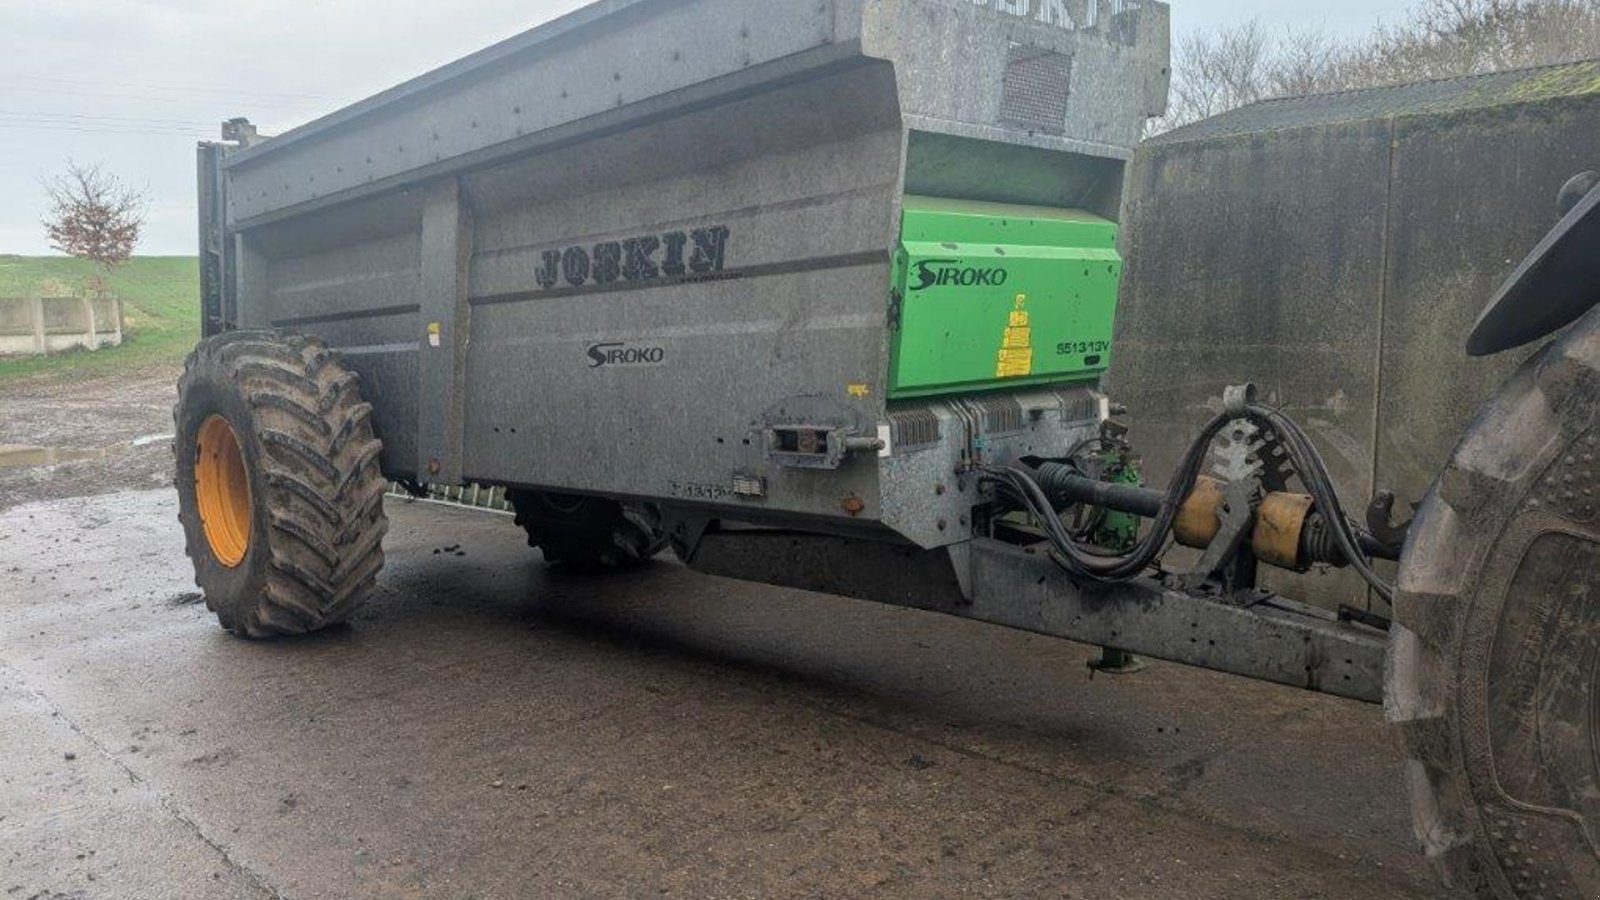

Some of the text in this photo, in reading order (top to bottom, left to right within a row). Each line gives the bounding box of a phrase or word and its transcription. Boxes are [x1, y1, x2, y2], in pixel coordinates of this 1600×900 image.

[535, 224, 730, 288] JOSKIN
[909, 259, 1007, 291] SIROKO
[587, 342, 664, 368] SIROKO
